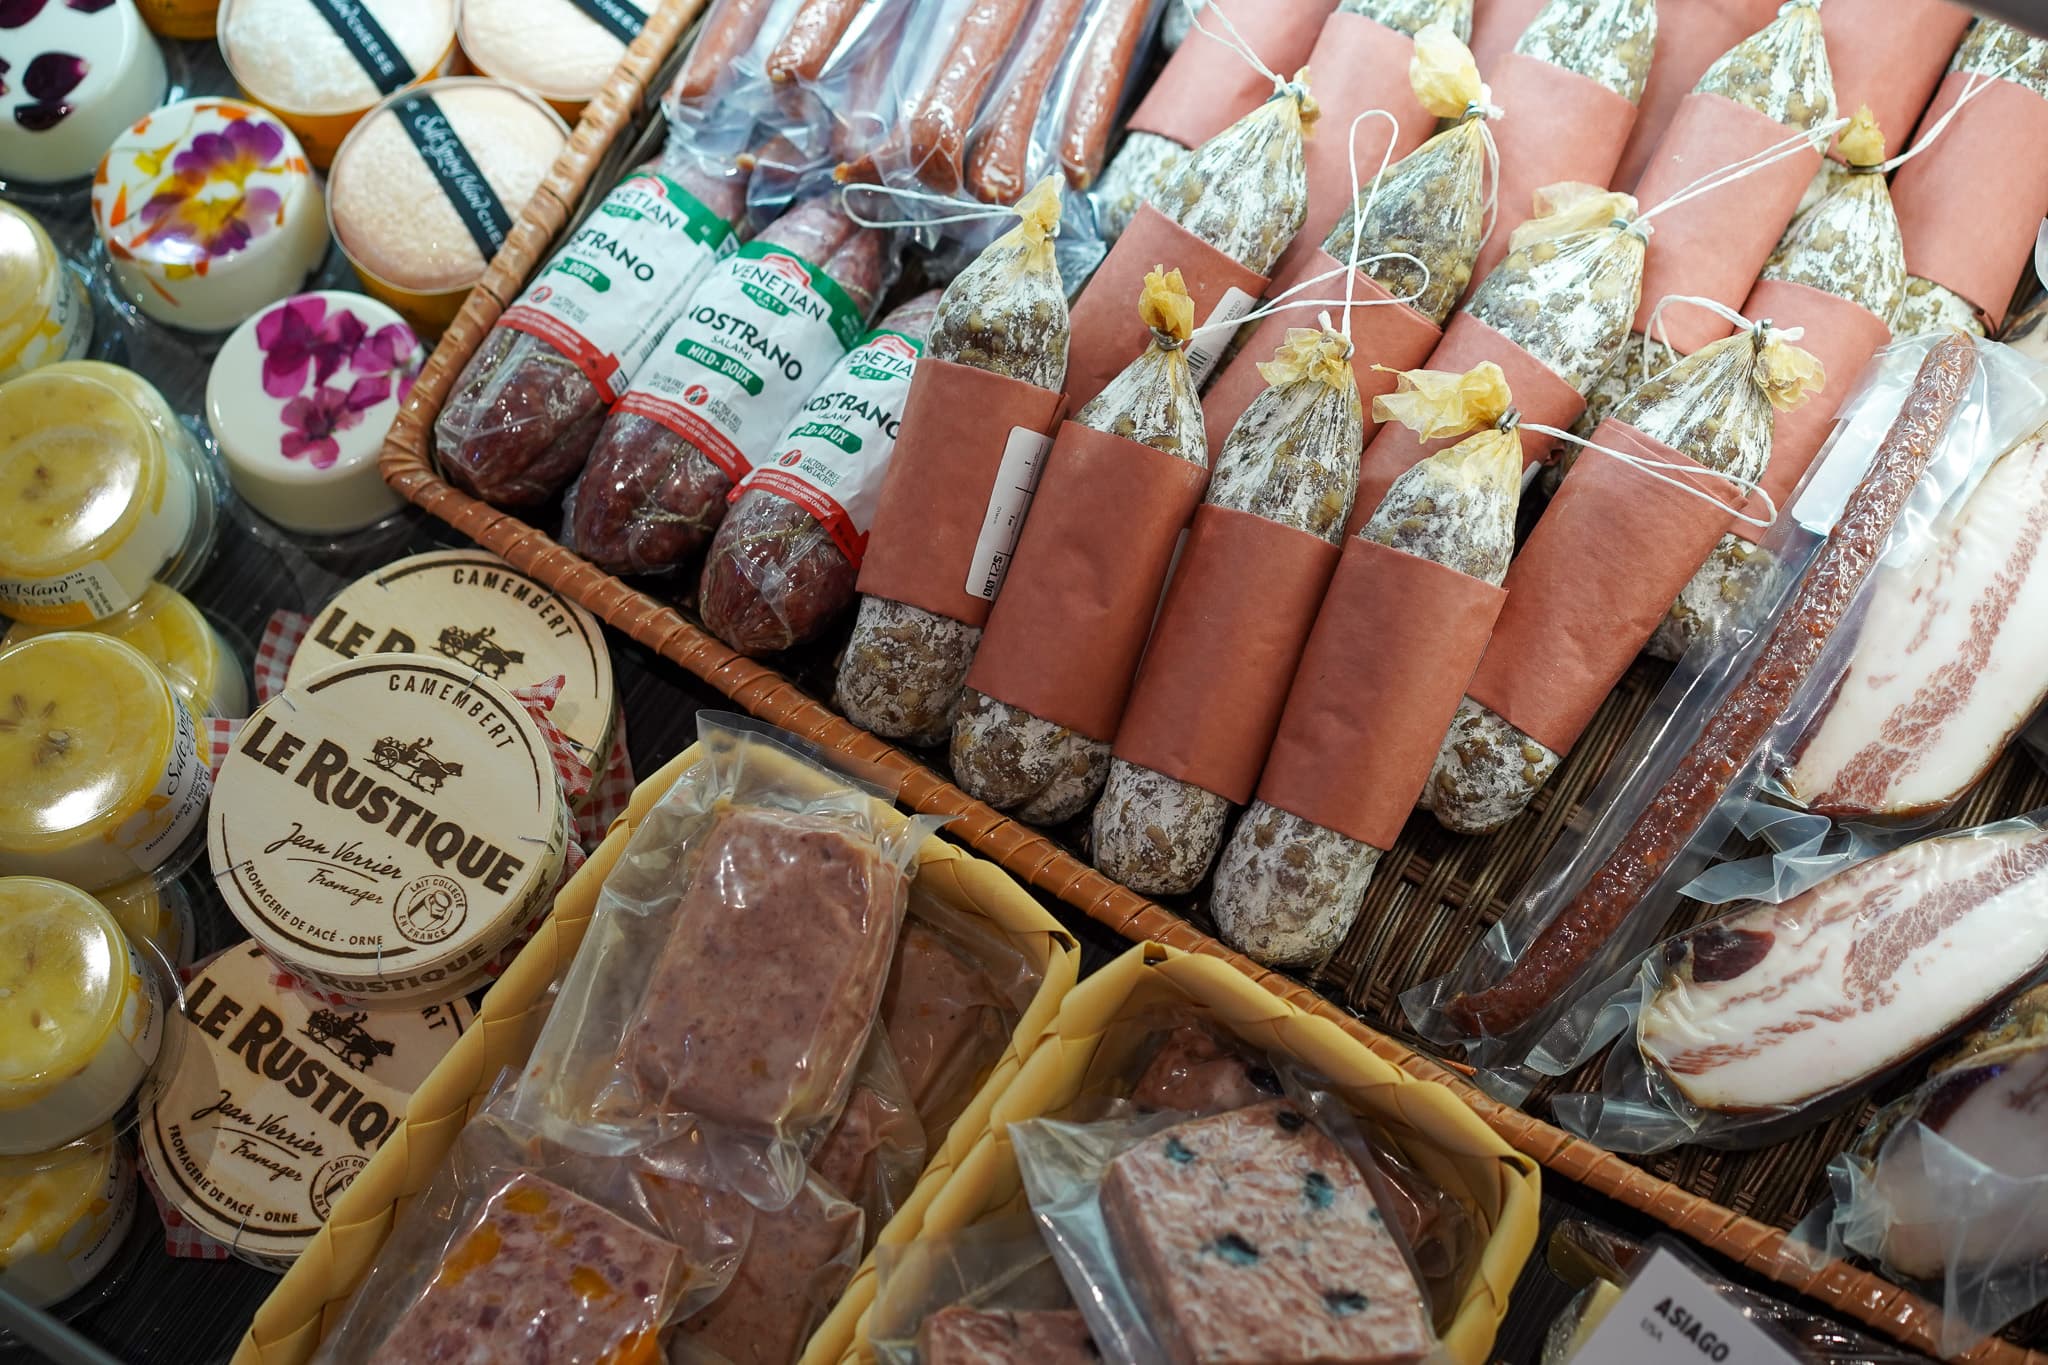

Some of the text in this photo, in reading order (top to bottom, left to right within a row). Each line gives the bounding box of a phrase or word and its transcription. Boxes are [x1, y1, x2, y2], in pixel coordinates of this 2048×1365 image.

[347, 16, 395, 76] CHEESE
[731, 262, 826, 322] VENETIAN
[747, 286, 784, 312] MEATS
[687, 344, 753, 389] MILD DOUX
[710, 334, 752, 360] SALAMI
[803, 455, 841, 482] LACTOSE FREE
[812, 471, 837, 488] LACTOSE
[982, 554, 1003, 598] $21.00
[453, 568, 573, 640] CAMEMBERT
[314, 608, 375, 659] LE
[389, 675, 514, 750] CAMEMBERT
[168, 740, 187, 795] Salt
[241, 716, 306, 775] LE
[294, 738, 525, 895] RUSTIQUE
[264, 822, 402, 879] Jean Verrier
[243, 859, 291, 921] FROMAGERIE
[290, 916, 305, 930] DE
[307, 925, 338, 942] PACÉ
[349, 936, 383, 945] ORNE
[308, 868, 383, 906] Fromager
[410, 879, 429, 893] LAIT
[398, 915, 448, 941] EN FRANCE
[313, 943, 488, 993] RUSTIQUE
[186, 977, 244, 1040] LE
[190, 1090, 325, 1158] Jean Verrier
[168, 1124, 211, 1191] FROMAGERIE
[209, 1185, 224, 1202] DE
[225, 1198, 254, 1217] PACÉ
[263, 1211, 298, 1224] ORNE
[231, 1138, 303, 1181] Fromager
[329, 1160, 349, 1173] LAIT
[1654, 1296, 1730, 1362] ASIAGO
